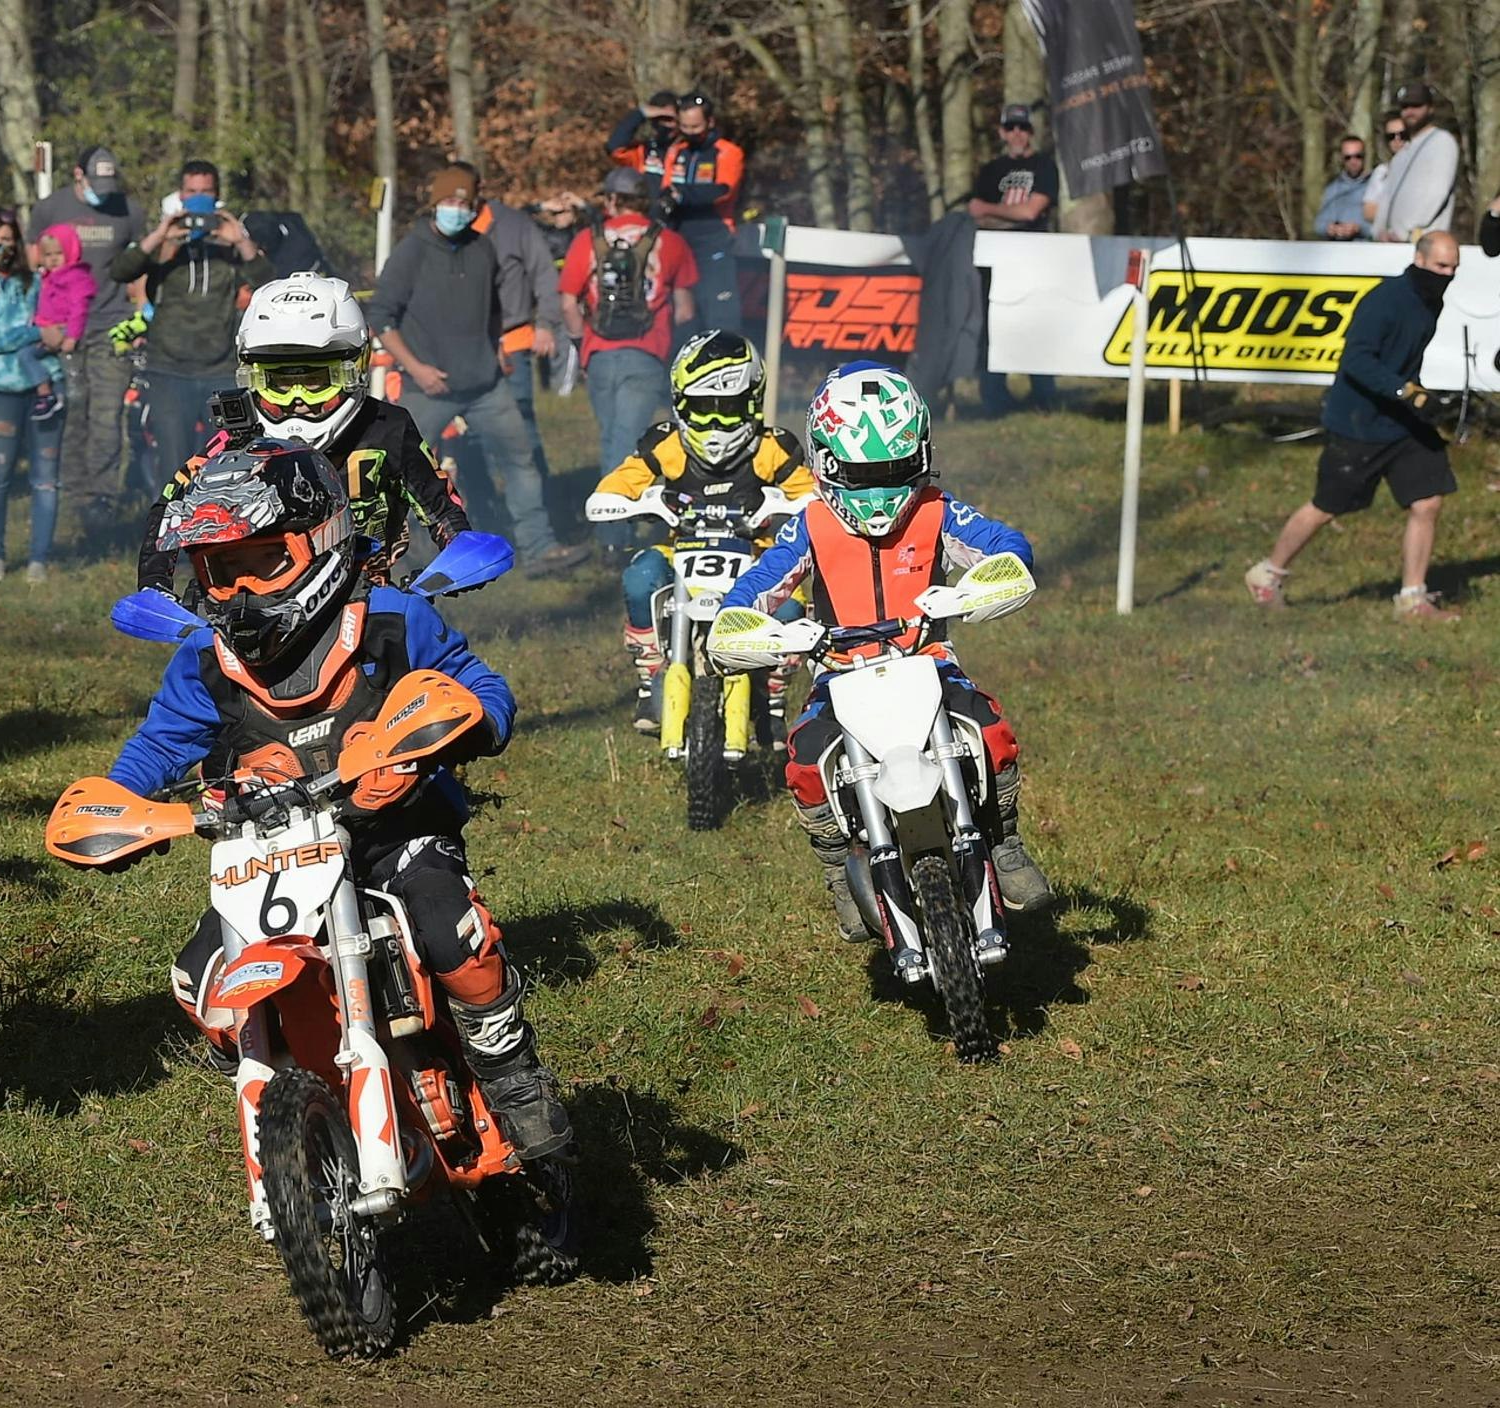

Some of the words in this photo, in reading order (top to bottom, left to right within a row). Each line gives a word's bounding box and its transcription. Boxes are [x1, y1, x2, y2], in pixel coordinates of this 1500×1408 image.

[1147, 285, 1358, 338] MOOS
[683, 555, 742, 579] 131
[961, 583, 1029, 609] ACERBIS
[713, 640, 782, 650] ACERBIS
[288, 716, 335, 748] LEATT
[76, 805, 126, 814] MOOSE
[211, 842, 343, 889] HUNTER
[259, 871, 298, 937] 6
